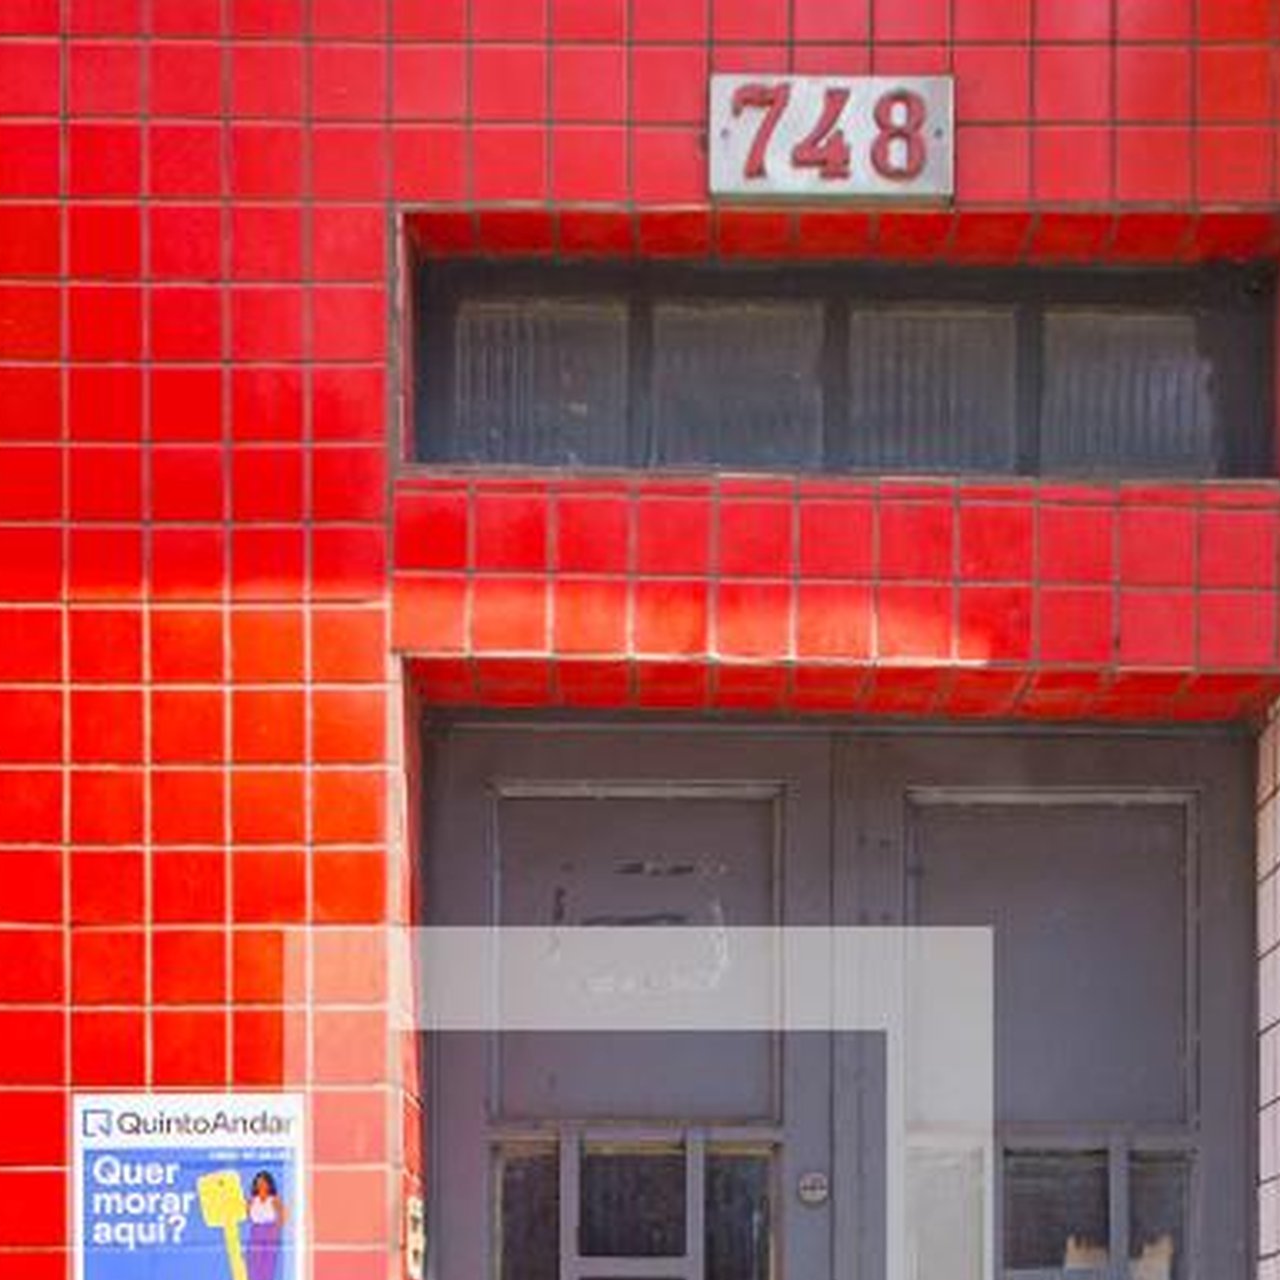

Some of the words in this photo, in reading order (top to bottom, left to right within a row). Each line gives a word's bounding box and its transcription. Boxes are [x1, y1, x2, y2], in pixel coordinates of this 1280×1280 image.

[731, 82, 928, 182] 748
[116, 1110, 294, 1136] QuintoAndar
[93, 1156, 180, 1185] Quer
[93, 1191, 195, 1214] morar
[93, 1216, 186, 1249] aqui?
